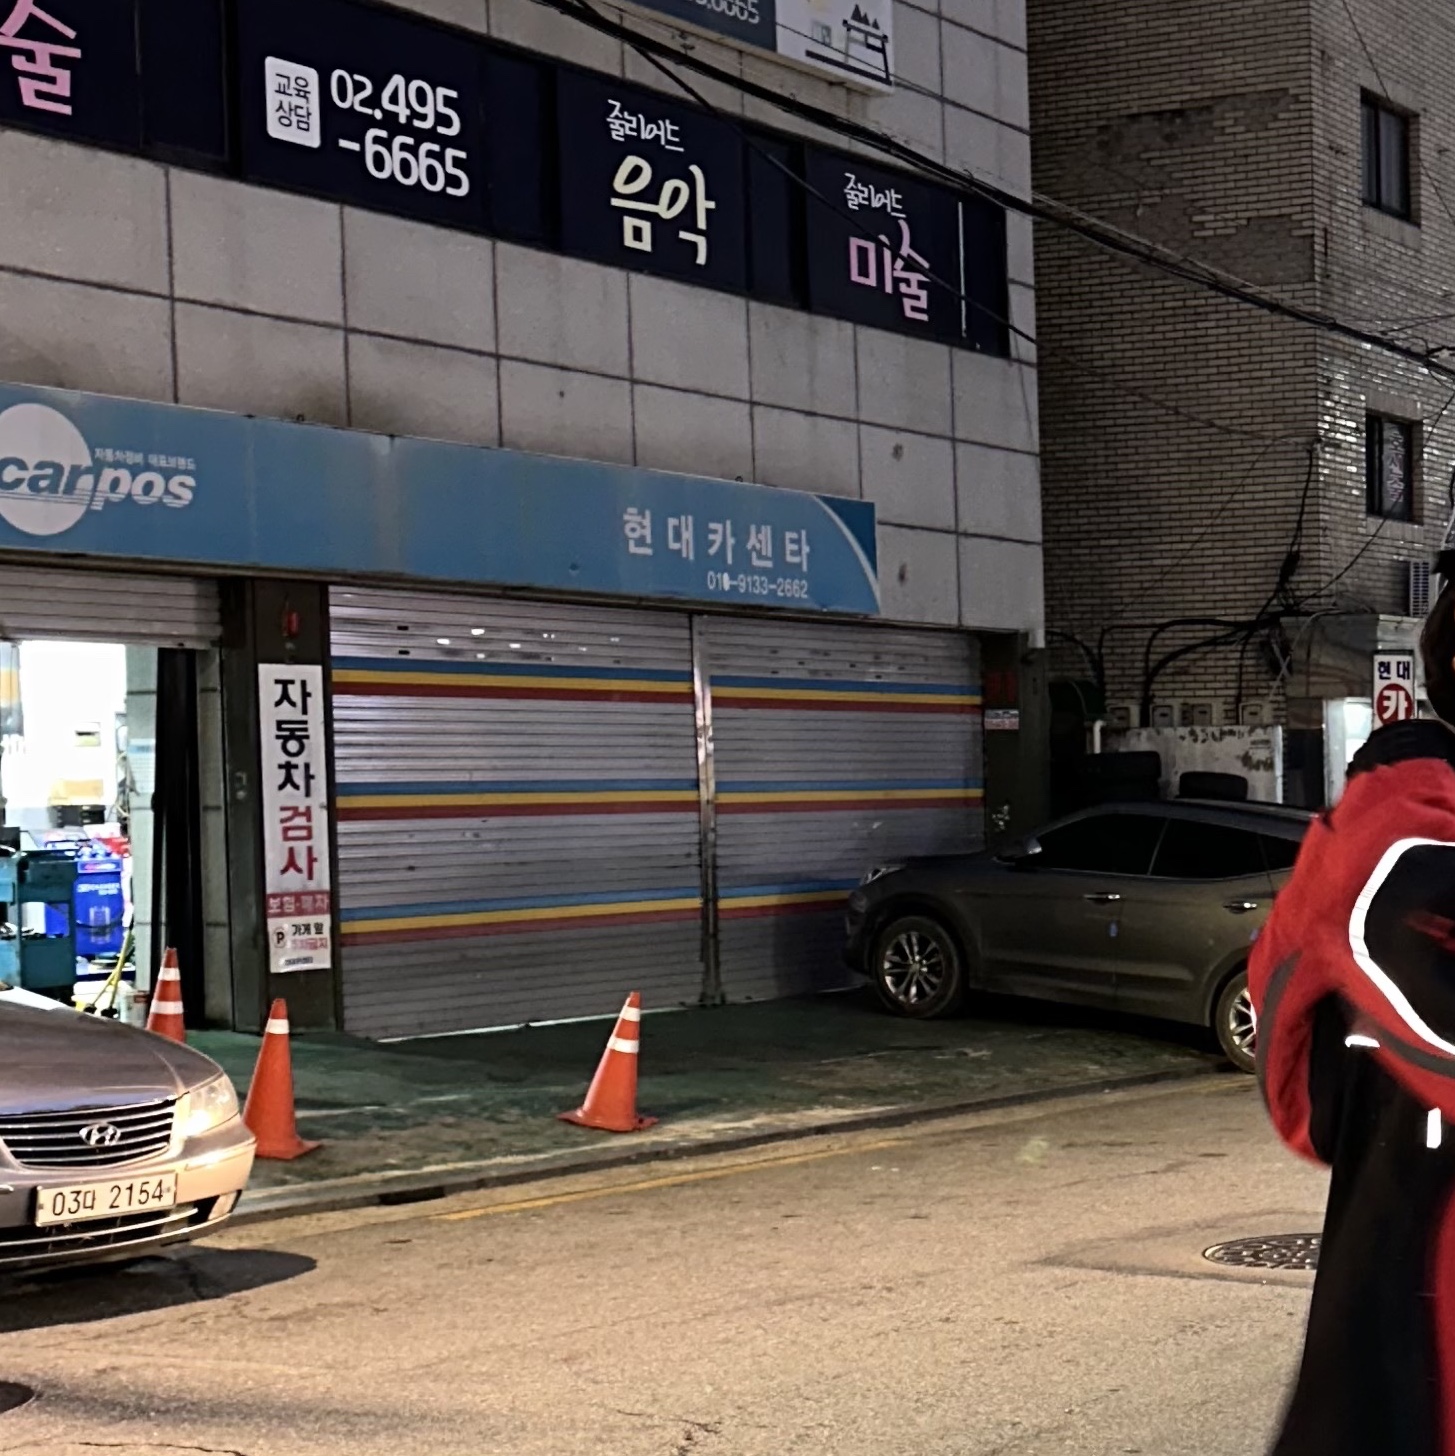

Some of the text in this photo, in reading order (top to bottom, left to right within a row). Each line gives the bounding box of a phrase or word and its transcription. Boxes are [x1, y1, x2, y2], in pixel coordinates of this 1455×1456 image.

[0, 0, 81, 116] 술
[274, 73, 311, 105] 교육
[275, 100, 312, 132] 상담
[330, 68, 461, 136] 02.495
[338, 127, 470, 197] -6665
[610, 155, 716, 266] 음악
[849, 219, 931, 322] 미술
[0, 456, 196, 512] carpos
[1378, 660, 1411, 681] 현대
[109, 1178, 164, 1210] 2154
